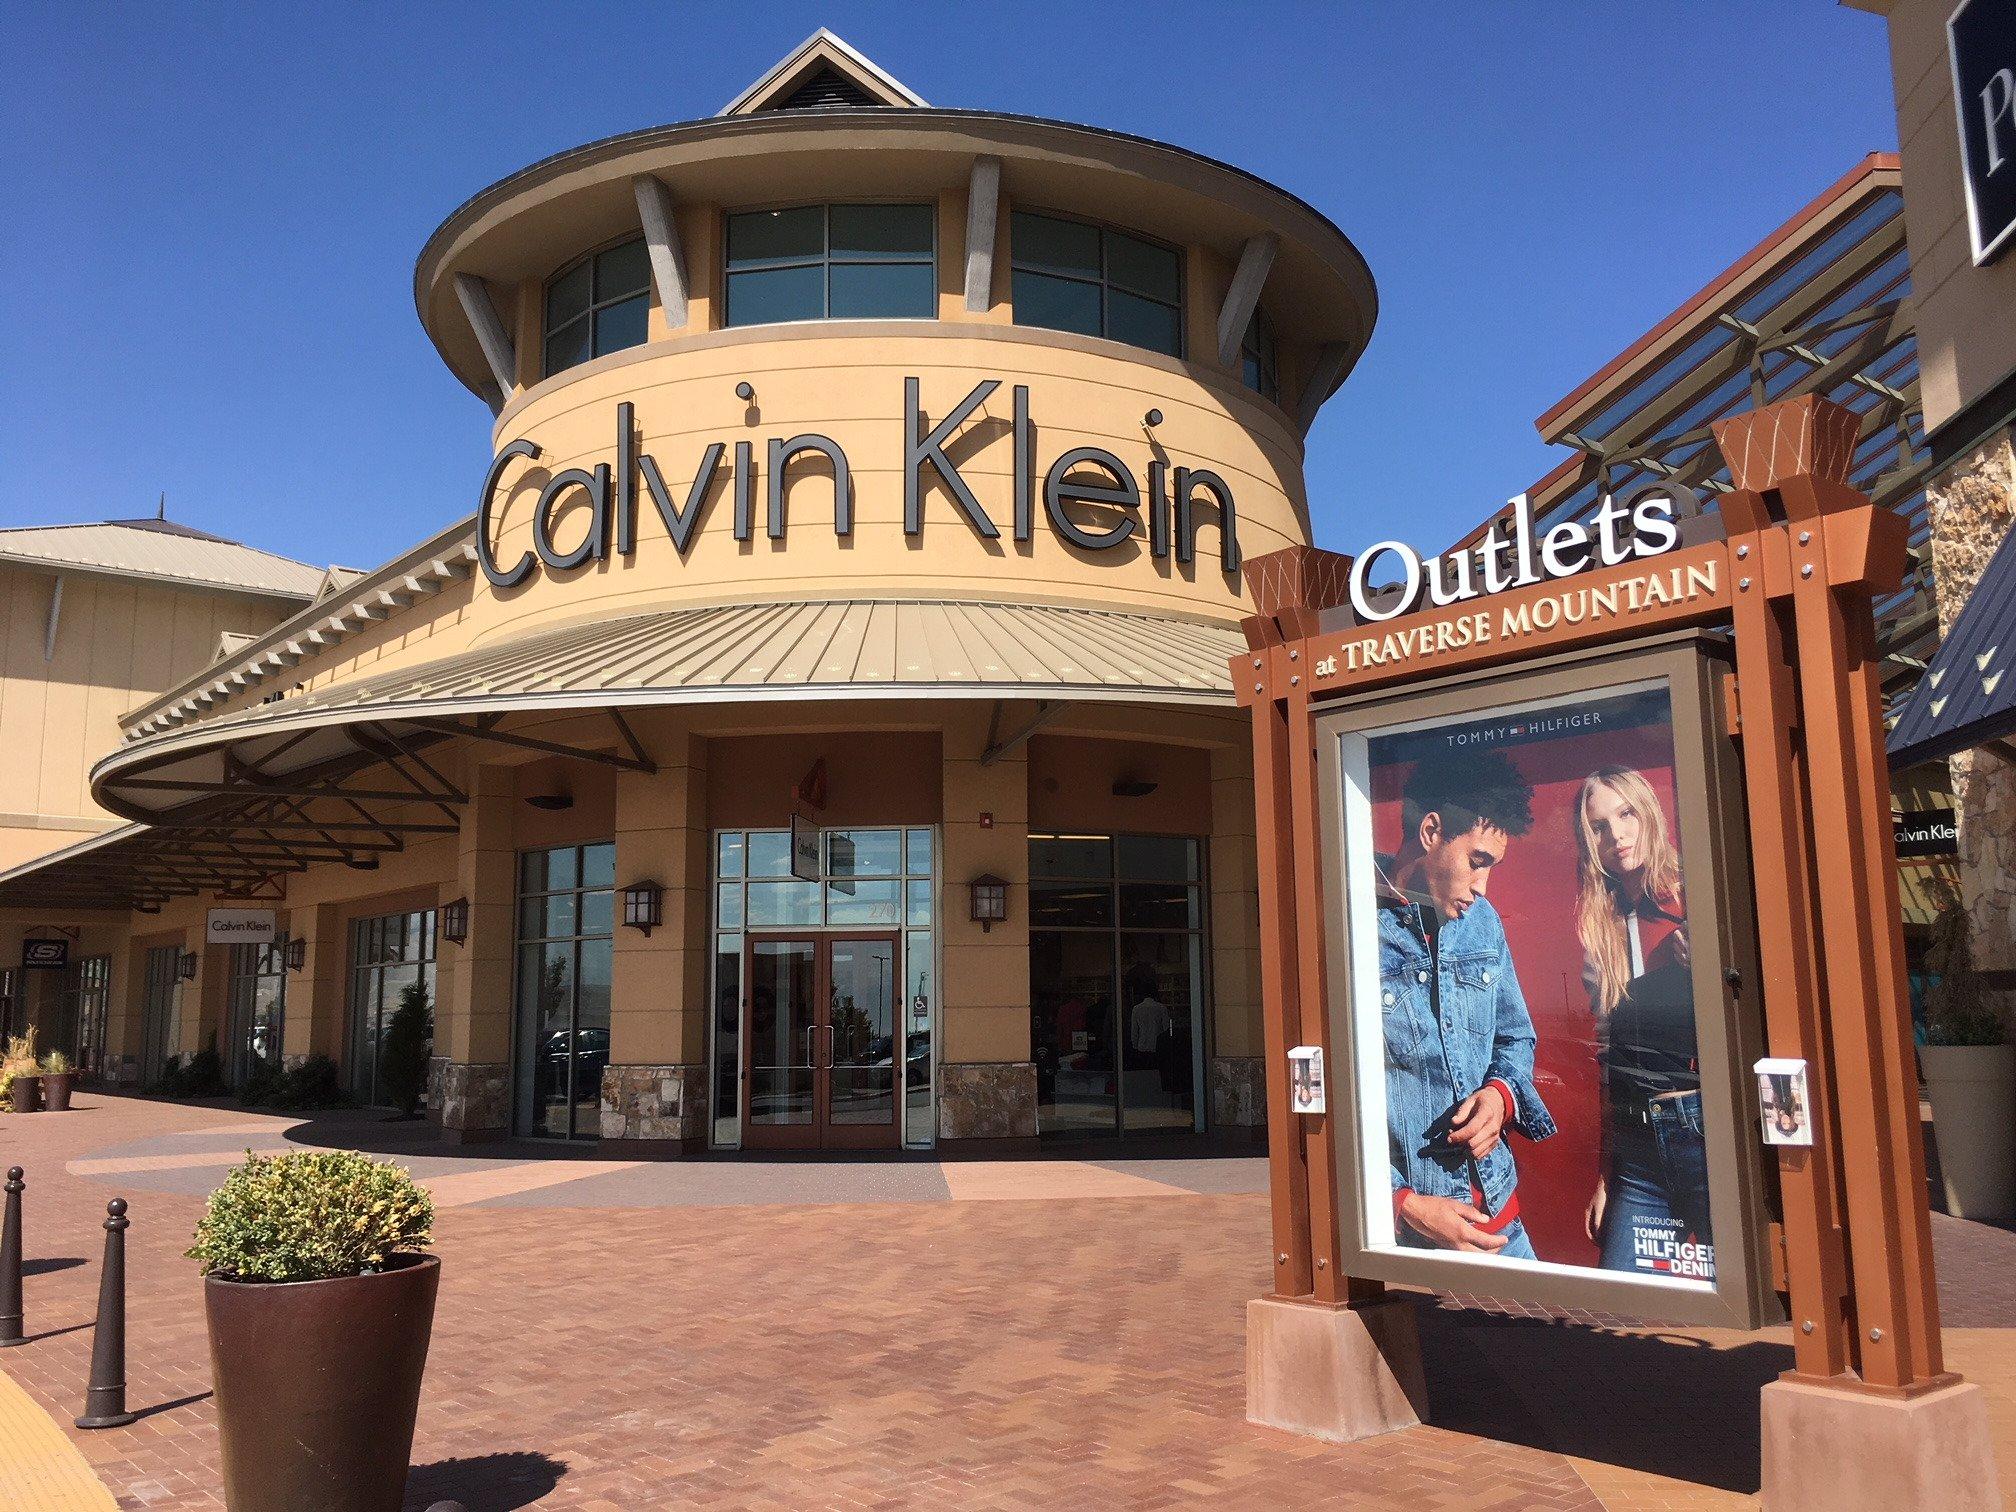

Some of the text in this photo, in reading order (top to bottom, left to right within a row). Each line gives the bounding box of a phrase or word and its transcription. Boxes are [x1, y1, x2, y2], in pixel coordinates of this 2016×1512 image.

[1978, 68, 2016, 177] P
[477, 376, 1238, 588] Calvin Klein
[1349, 493, 1678, 622] Outlets
[1315, 560, 1718, 677] at TRAVERSE MOUNTAIN
[1447, 712, 1602, 747] TOMMY HILFIGER
[1894, 826, 1929, 842] alvin
[212, 920, 271, 931] Calvin Klein
[1632, 1215, 1684, 1228] INTRODUCING
[1632, 1227, 1676, 1241] TOMMY
